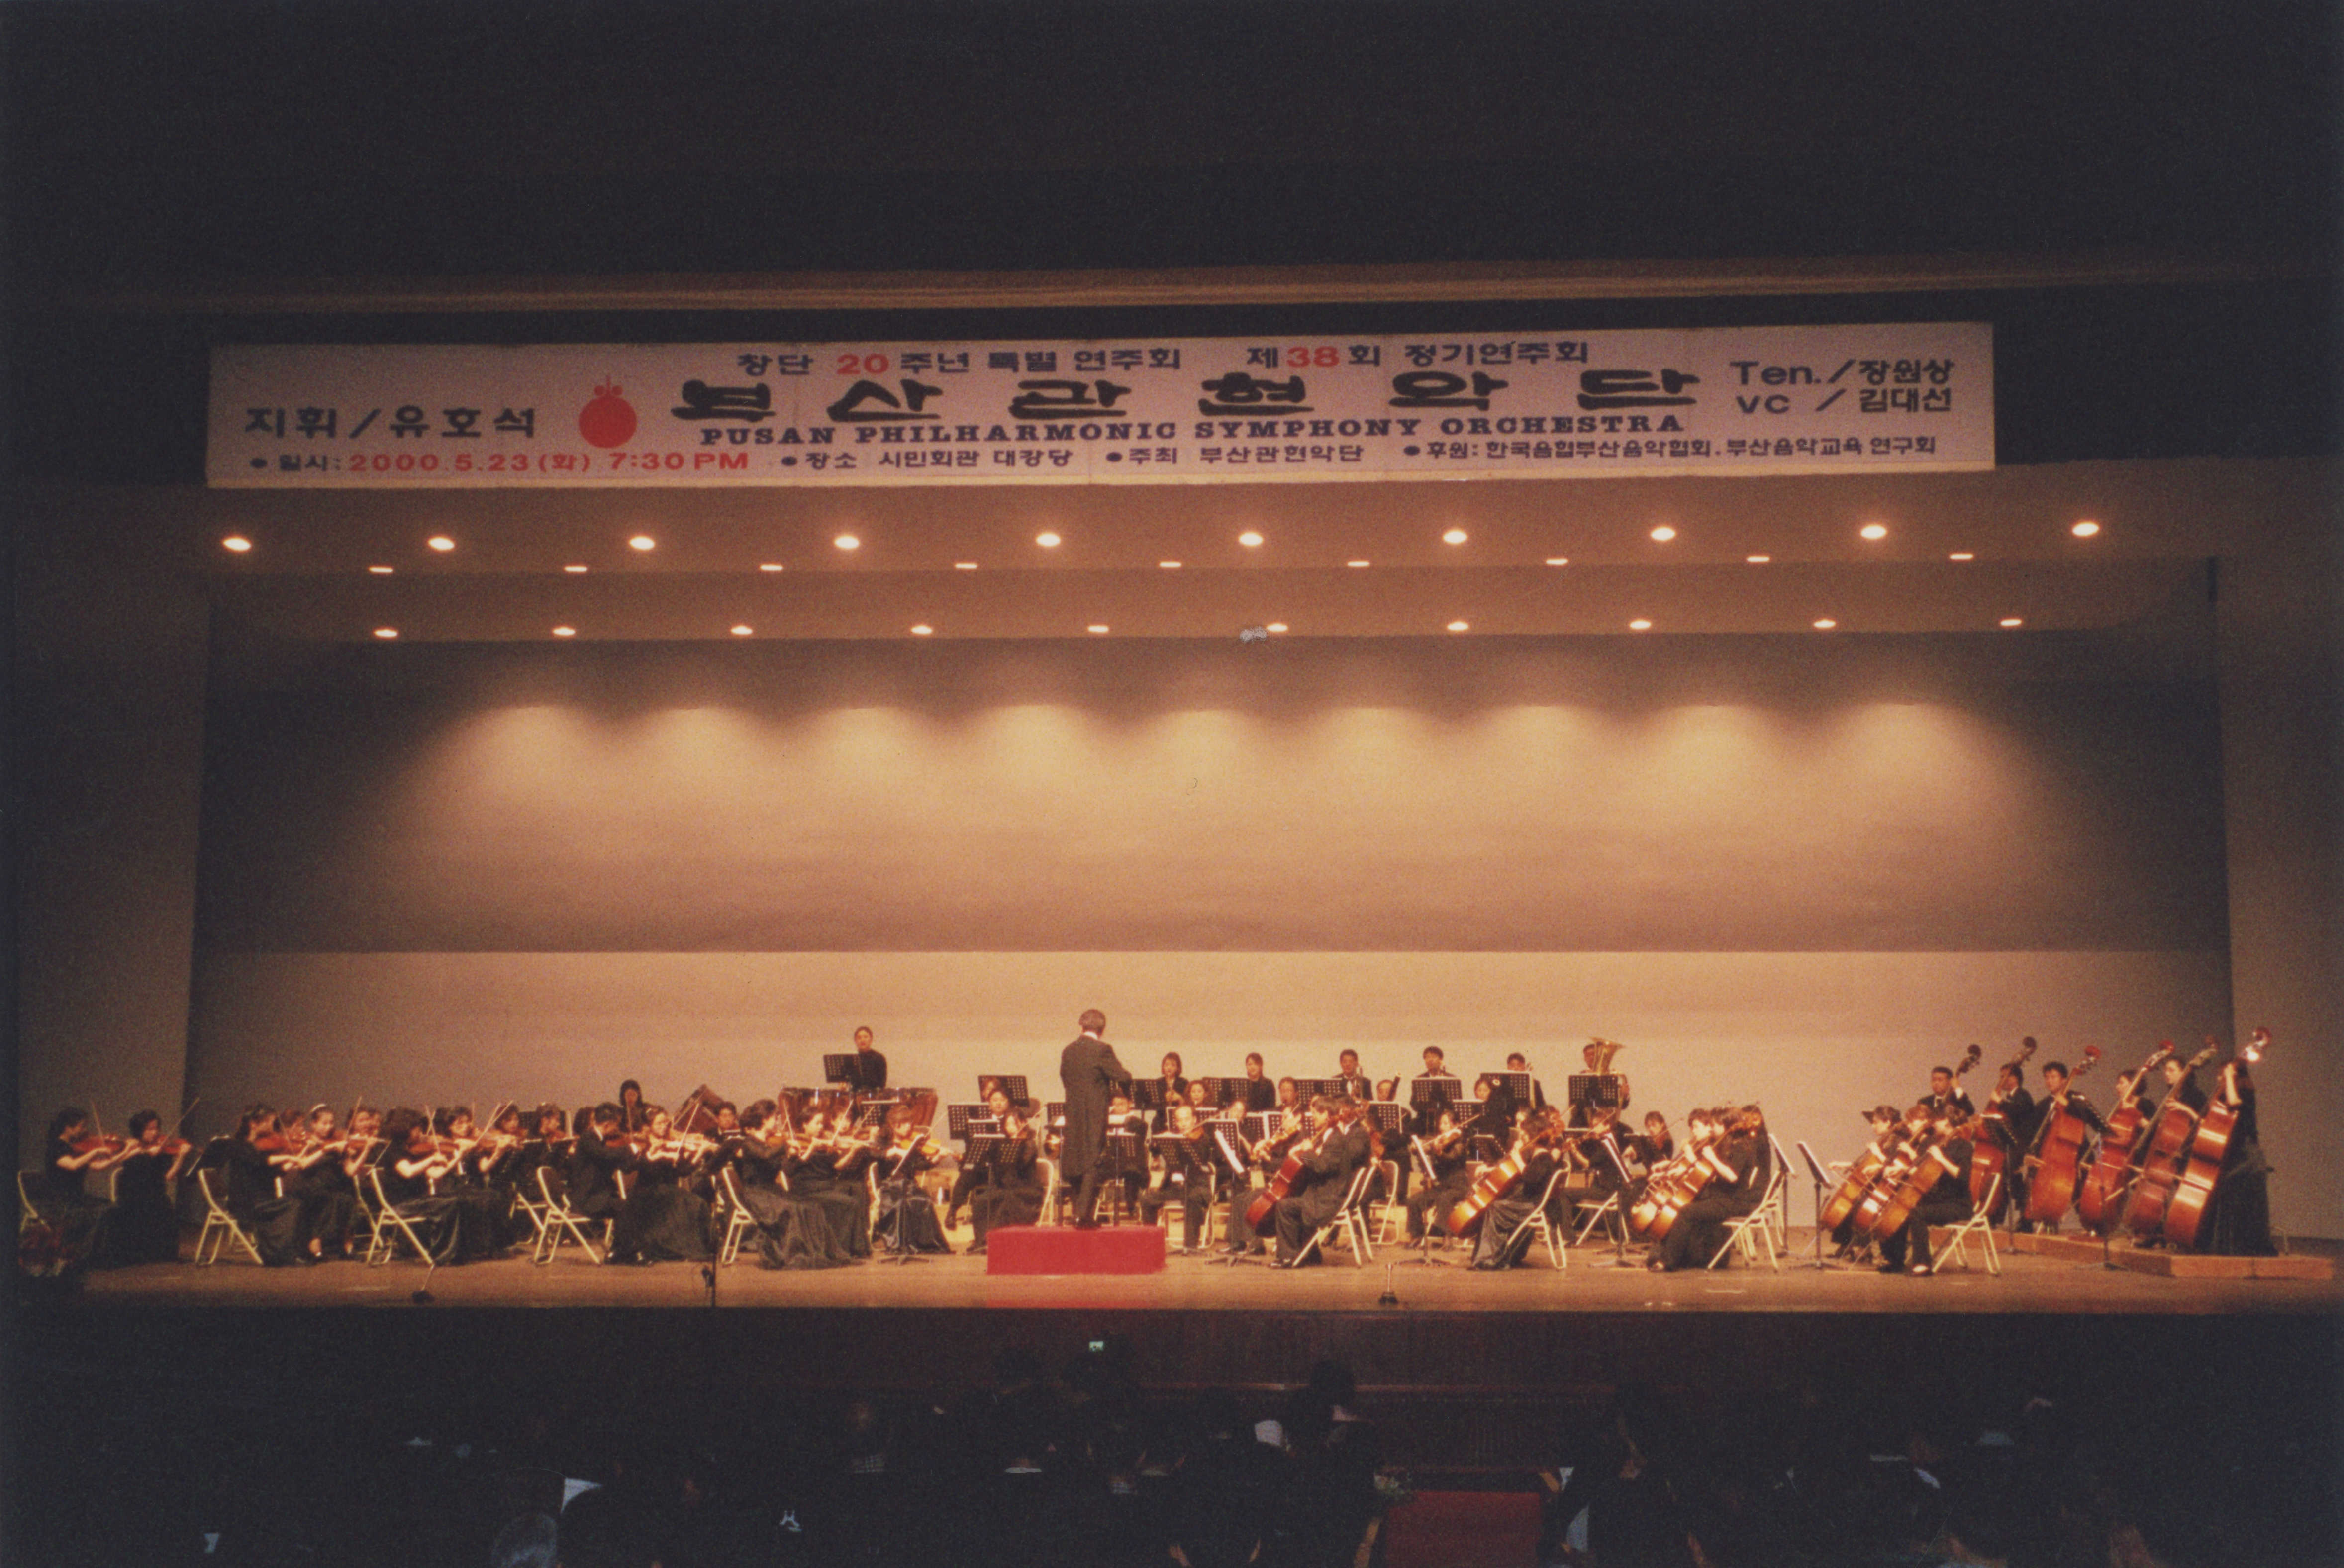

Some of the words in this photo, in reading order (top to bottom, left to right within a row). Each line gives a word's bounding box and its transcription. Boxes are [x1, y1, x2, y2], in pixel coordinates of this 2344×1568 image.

[738, 354, 813, 376] 창단
[989, 352, 1057, 372] 특별
[1074, 348, 1180, 371] 연주회
[1405, 341, 1588, 367] 정기연주회
[1860, 388, 1951, 412] 김대선
[701, 427, 835, 445] PUSAN
[855, 422, 1176, 443] PHILHARMONIC
[1196, 418, 1421, 438] SYMPHONY
[1440, 415, 1683, 434] ORCHESTRA
[609, 452, 684, 470] 7:30
[694, 453, 748, 469] PM
[806, 452, 855, 470] 장소
[879, 450, 979, 468] 시민회관
[993, 449, 1073, 467] 대강당
[1130, 447, 1177, 464] 주최
[1201, 445, 1364, 463] 부산관현악단
[1870, 436, 1936, 454] 연구회
